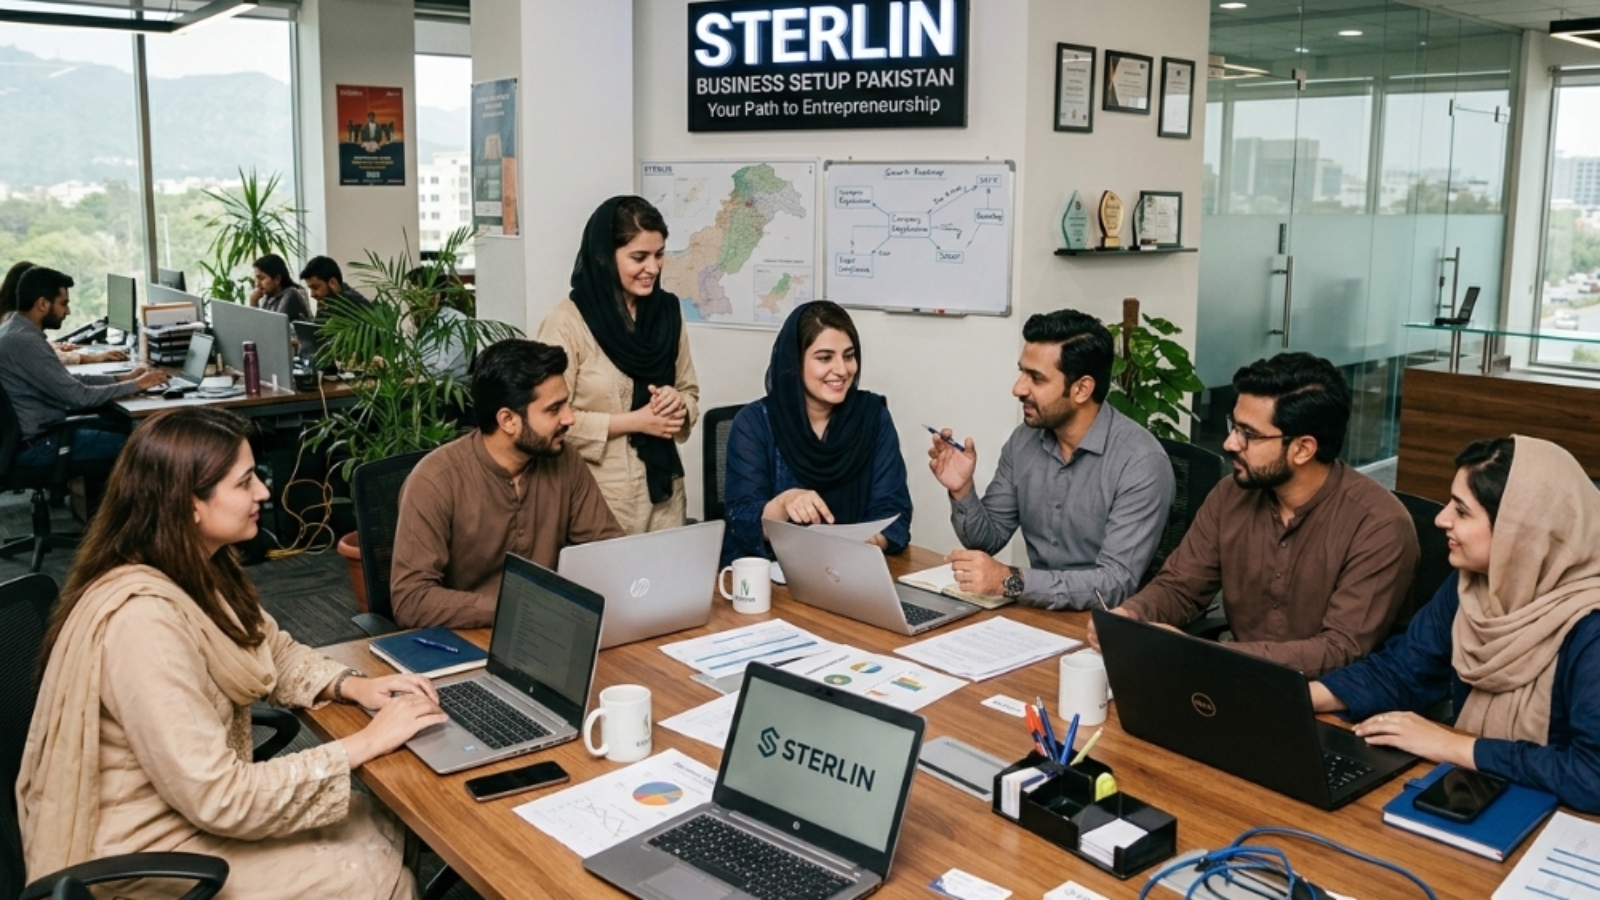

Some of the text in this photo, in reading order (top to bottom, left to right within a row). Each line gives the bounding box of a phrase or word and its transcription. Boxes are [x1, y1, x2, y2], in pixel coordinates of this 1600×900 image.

[694, 0, 956, 68] STERLIN
[696, 67, 955, 95] BUSINESS SETUP PAKISTAN
[707, 95, 941, 118] Your Path to Entrepreneurship
[782, 738, 876, 792] STERLIN
